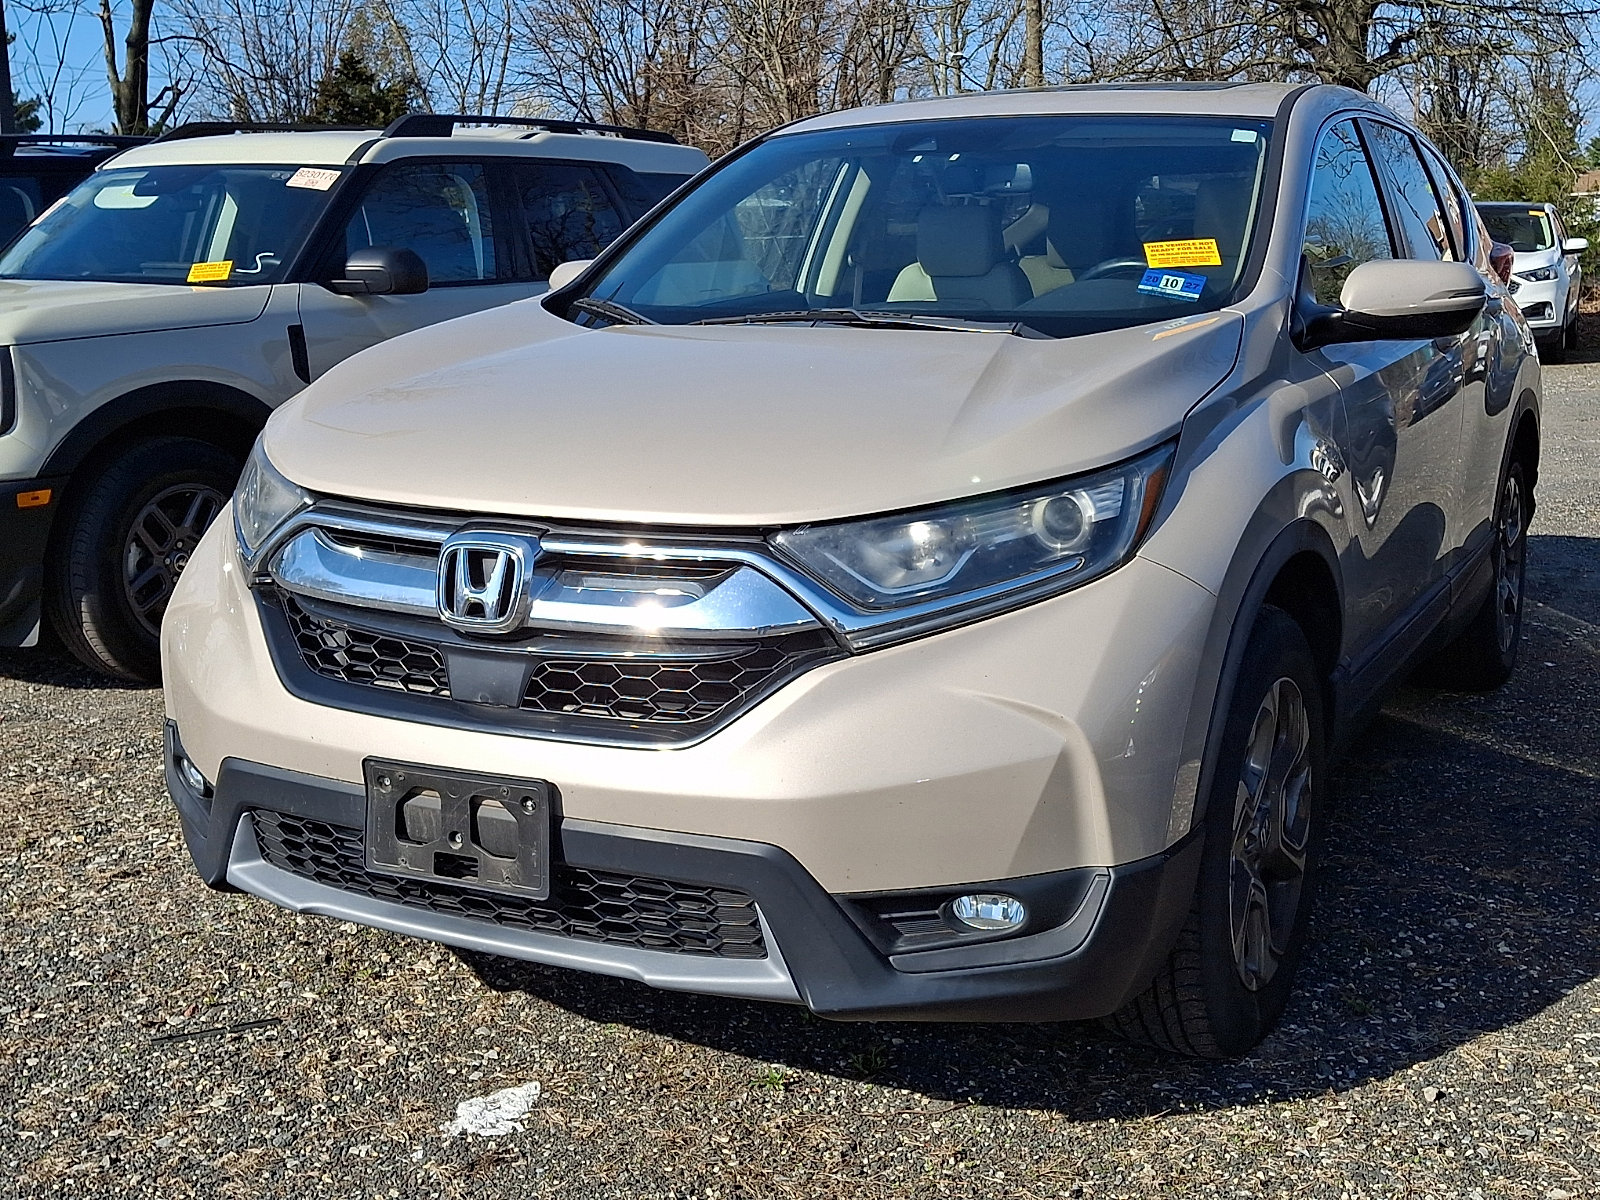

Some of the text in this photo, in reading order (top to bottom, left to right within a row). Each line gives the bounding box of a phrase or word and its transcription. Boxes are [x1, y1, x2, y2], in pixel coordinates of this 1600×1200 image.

[1144, 275, 1200, 290] 20 10 27
